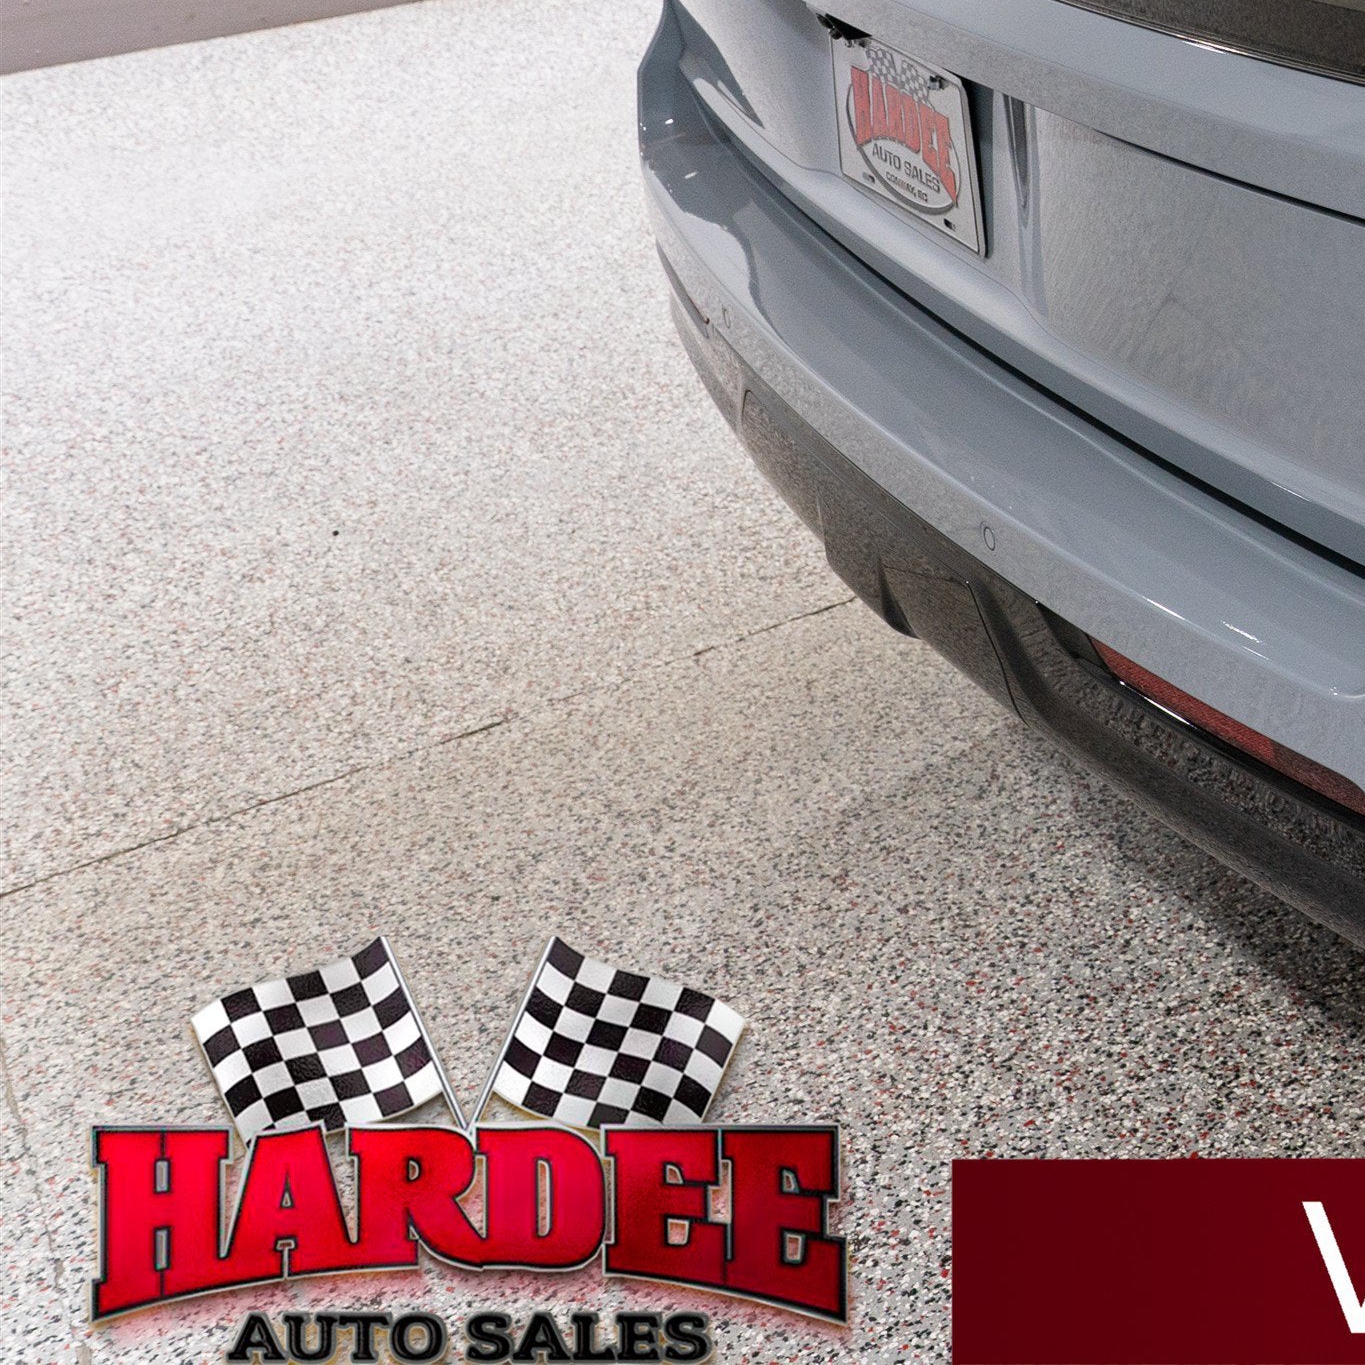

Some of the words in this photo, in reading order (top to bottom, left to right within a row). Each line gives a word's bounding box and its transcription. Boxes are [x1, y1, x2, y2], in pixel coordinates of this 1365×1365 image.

[850, 65, 958, 203] HARDEE
[872, 143, 901, 170] AUTO
[904, 161, 941, 193] SALES
